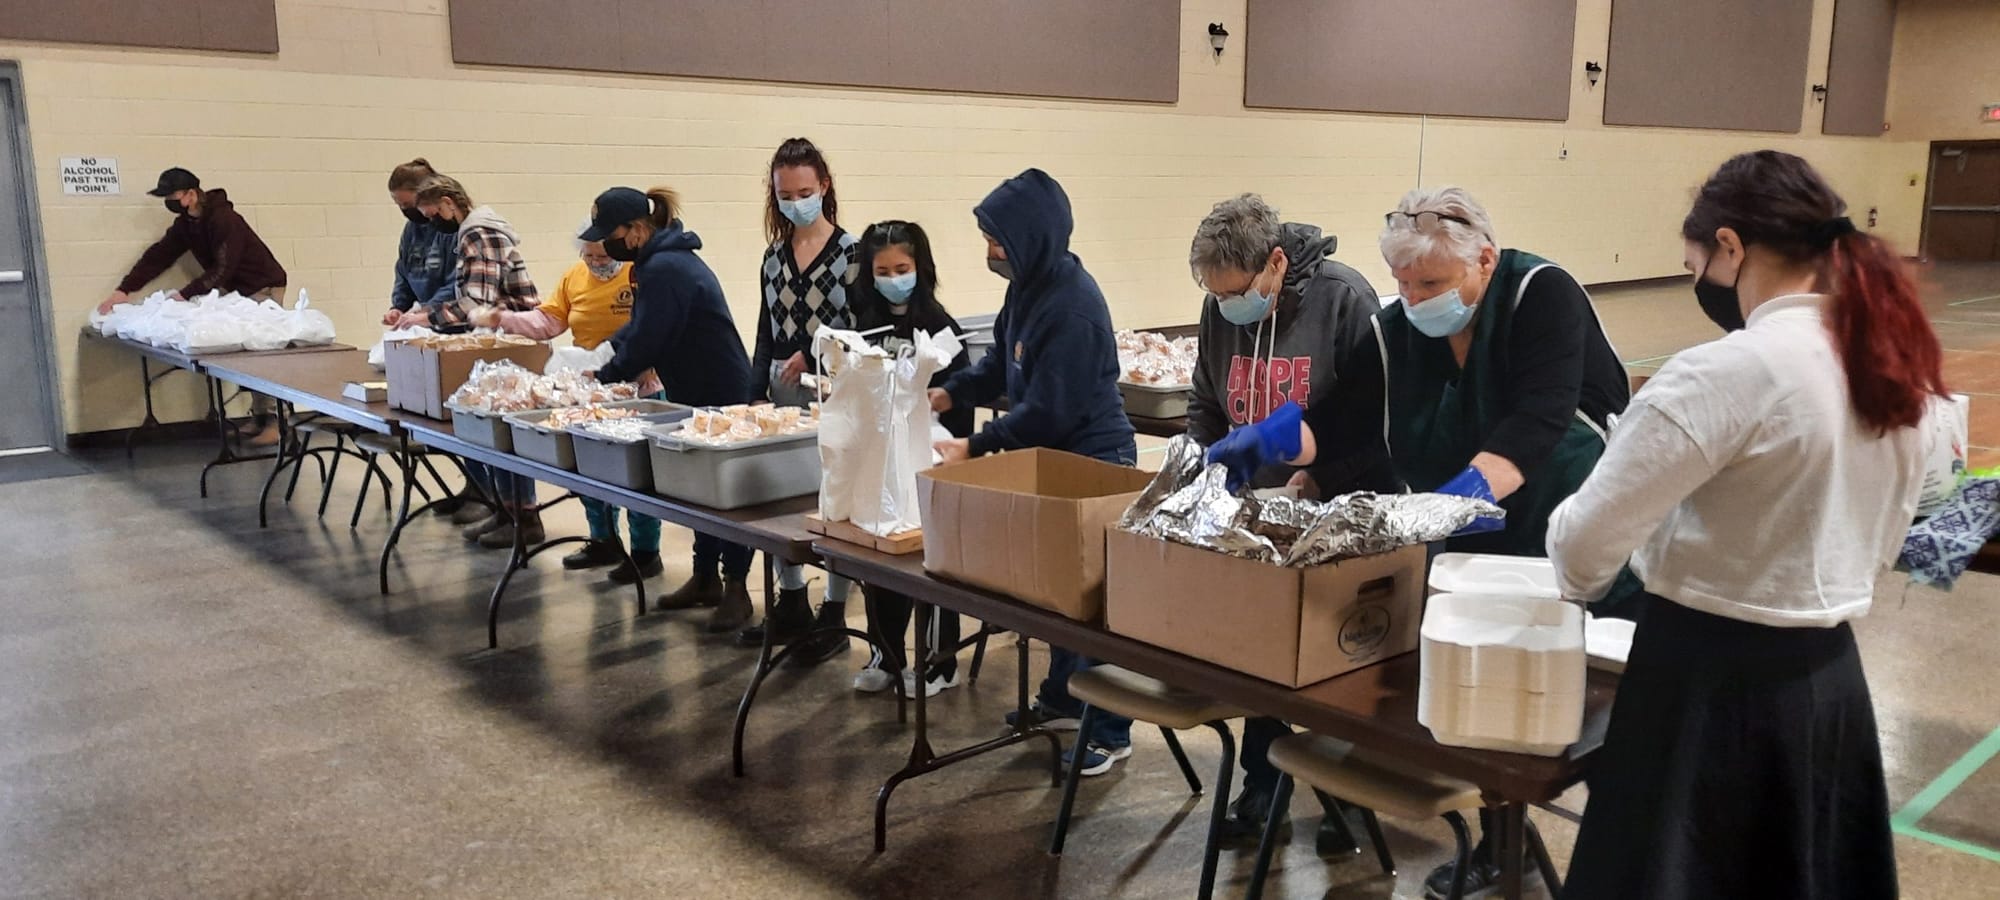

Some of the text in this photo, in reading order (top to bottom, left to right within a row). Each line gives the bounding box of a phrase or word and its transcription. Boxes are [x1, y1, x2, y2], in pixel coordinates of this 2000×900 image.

[81, 158, 97, 166] NO
[64, 167, 115, 175] ALCOHOL
[64, 176, 118, 184] PAST THIS
[75, 185, 109, 193] POINT.
[1227, 354, 1312, 393] HOPE
